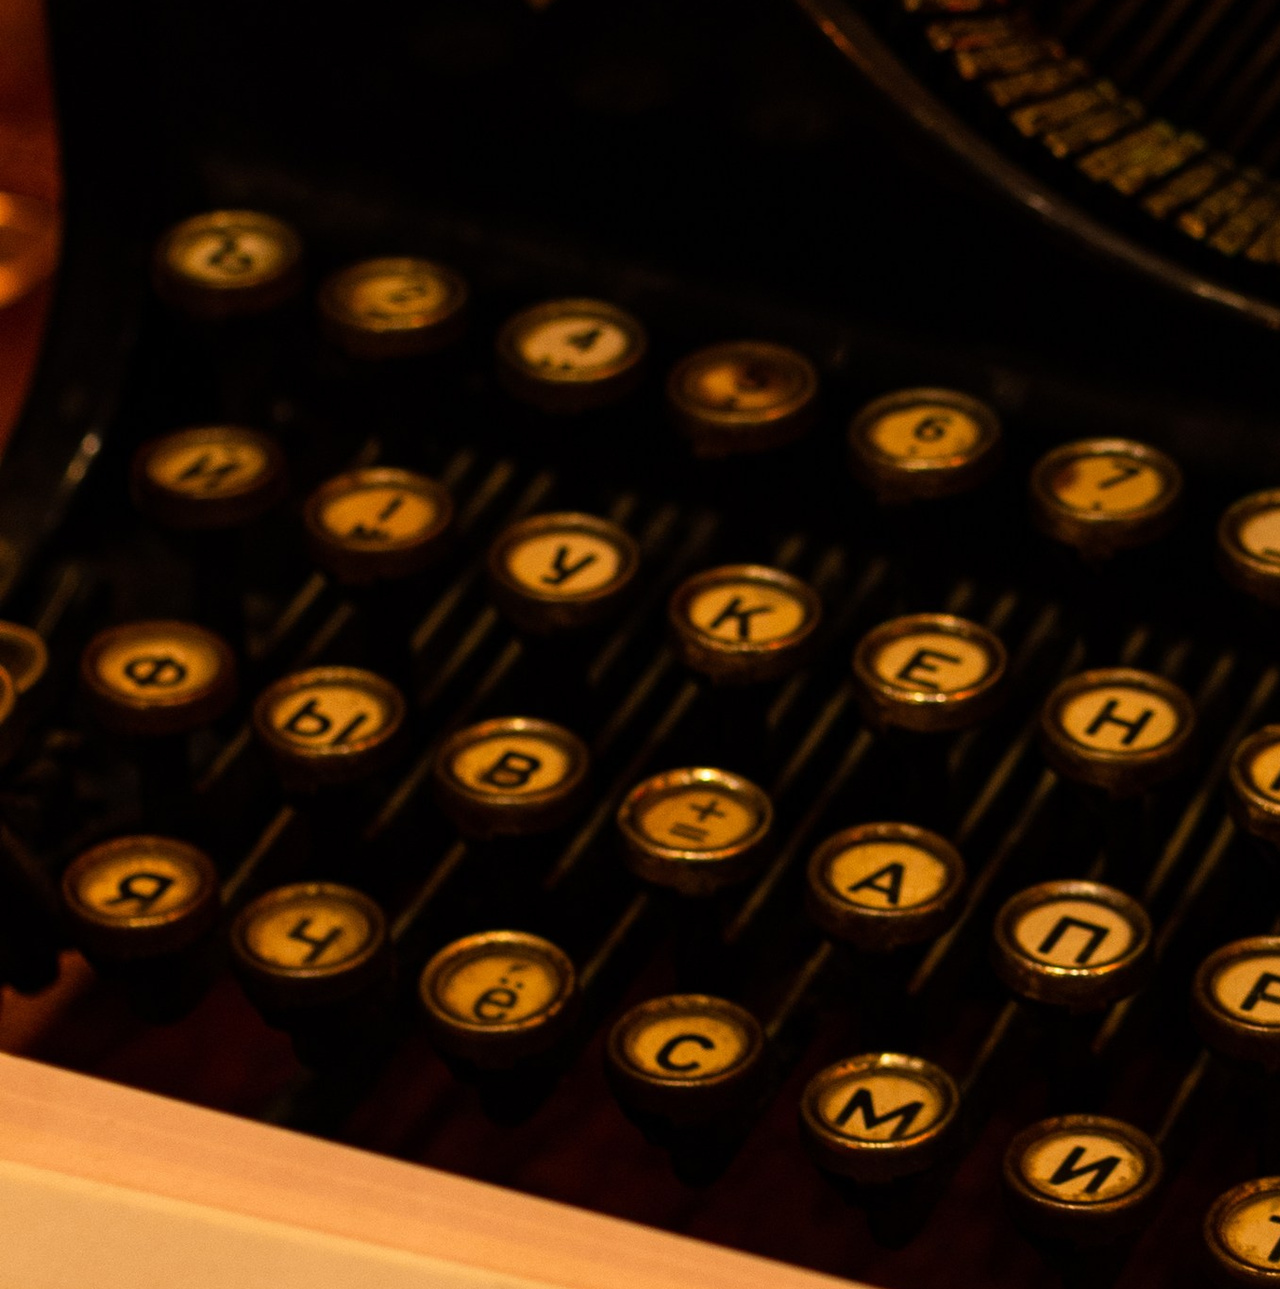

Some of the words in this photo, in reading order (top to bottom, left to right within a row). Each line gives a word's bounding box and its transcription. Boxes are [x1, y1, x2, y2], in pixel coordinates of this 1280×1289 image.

[540, 546, 595, 586] У
[708, 597, 772, 639] К
[895, 647, 962, 691] Е
[282, 698, 370, 749] Ы
[1083, 698, 1154, 746] Н
[477, 749, 542, 789] В
[104, 872, 175, 915] Я
[847, 862, 905, 906] А
[1037, 915, 1110, 966] П
[655, 1032, 716, 1072] С
[832, 1086, 927, 1141] М
[1047, 1145, 1123, 1194] И
